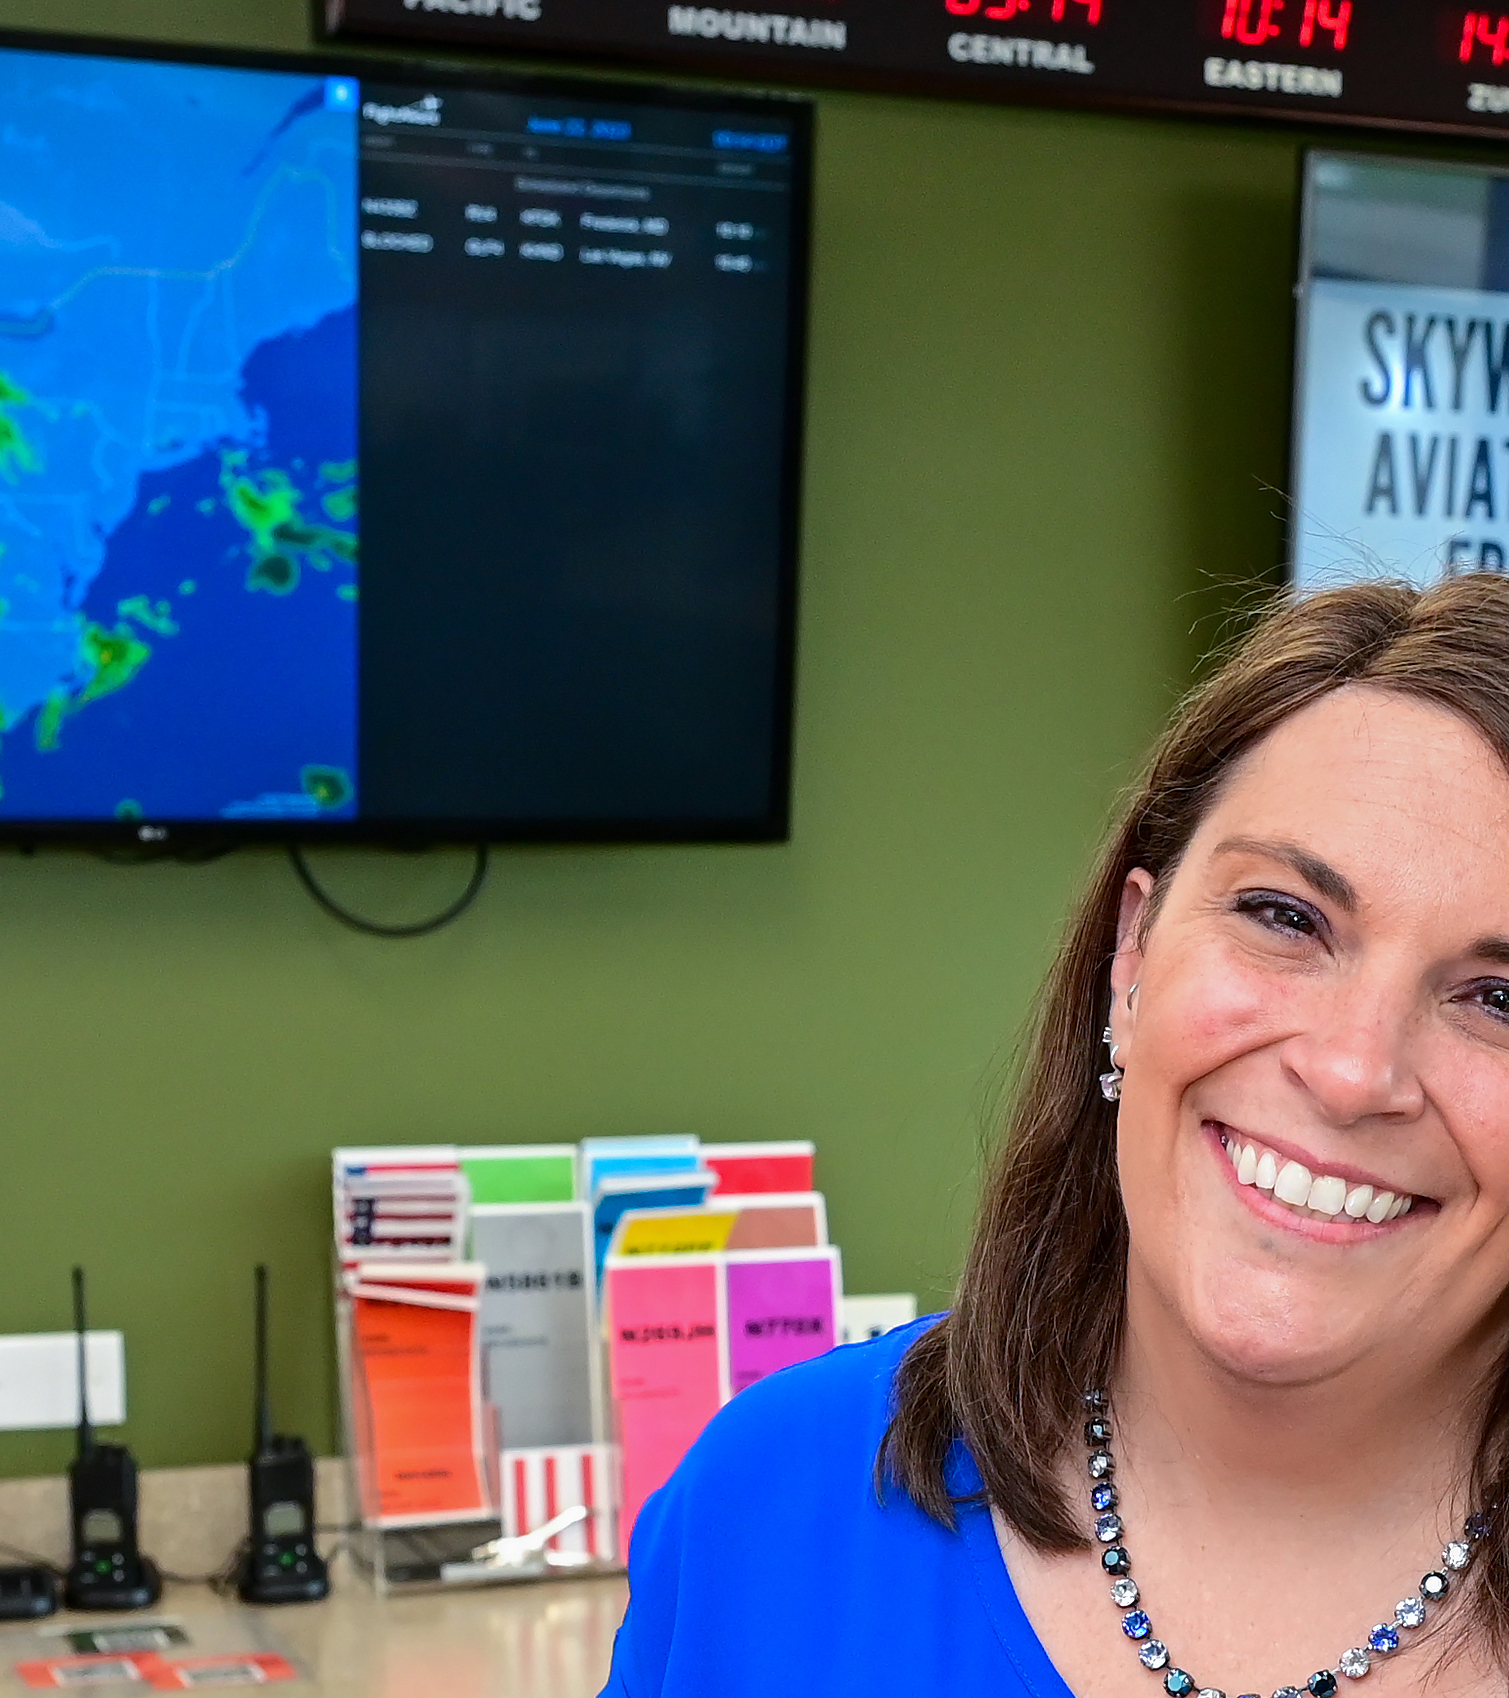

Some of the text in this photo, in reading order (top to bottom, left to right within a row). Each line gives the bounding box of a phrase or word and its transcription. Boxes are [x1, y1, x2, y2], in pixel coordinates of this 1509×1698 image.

[667, 4, 846, 51] MOUNTAIN
[947, 31, 1095, 74] CENTRAL
[1203, 56, 1342, 98] EASTERN
